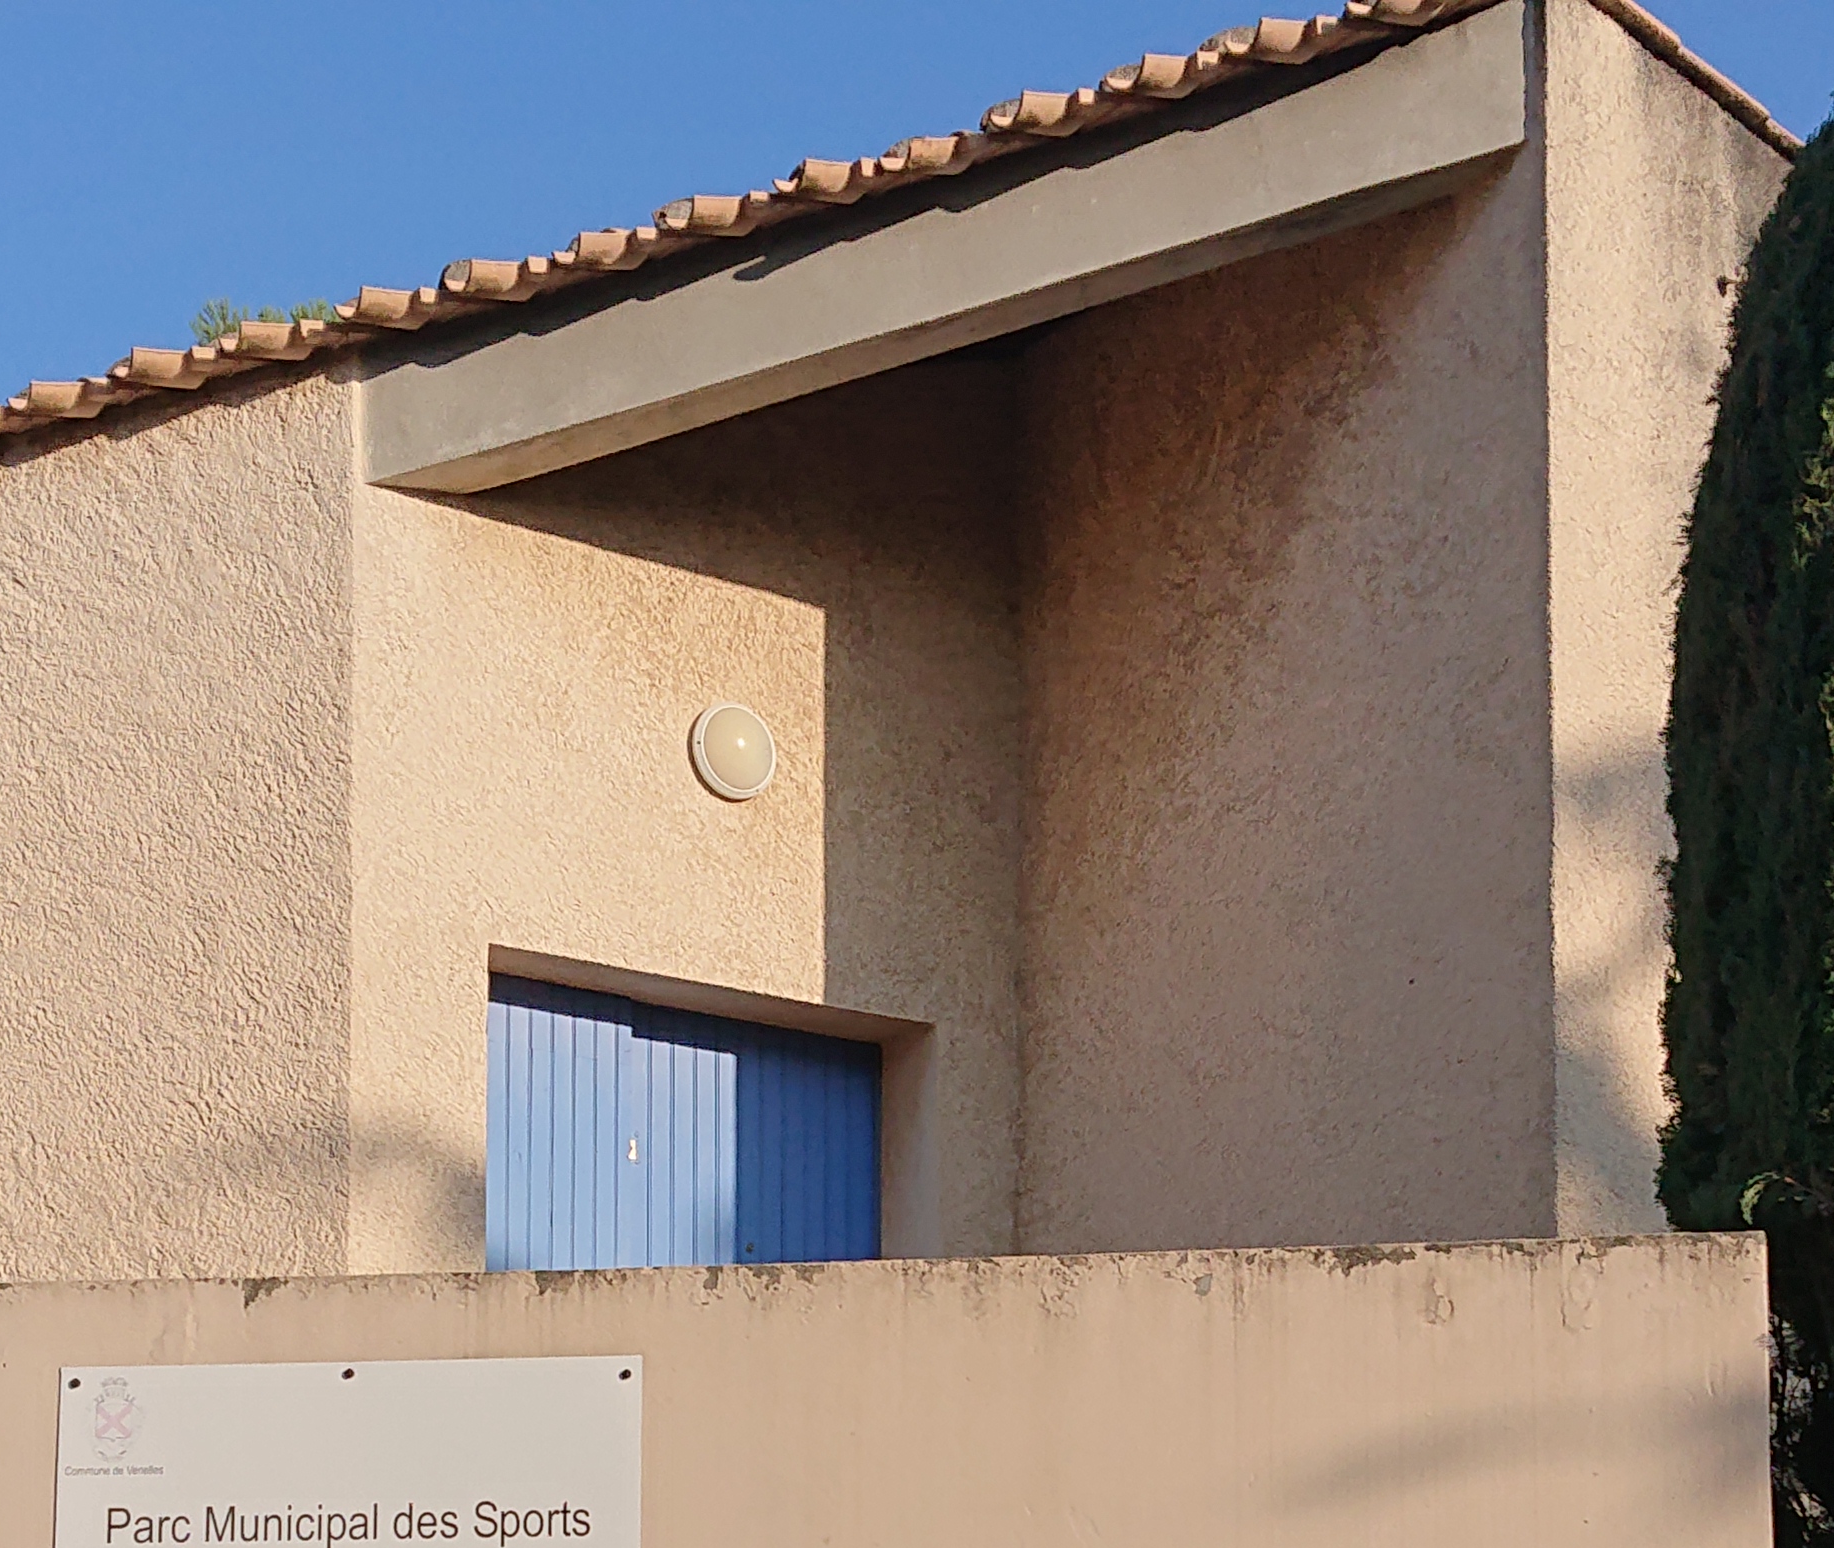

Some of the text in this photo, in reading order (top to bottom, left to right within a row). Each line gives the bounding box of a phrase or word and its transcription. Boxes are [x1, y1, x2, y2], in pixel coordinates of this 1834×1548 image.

[64, 1465, 164, 1476] Commune de Venelles
[106, 1507, 191, 1544] Parc
[393, 1502, 459, 1540] des
[473, 1500, 591, 1548] Sports
